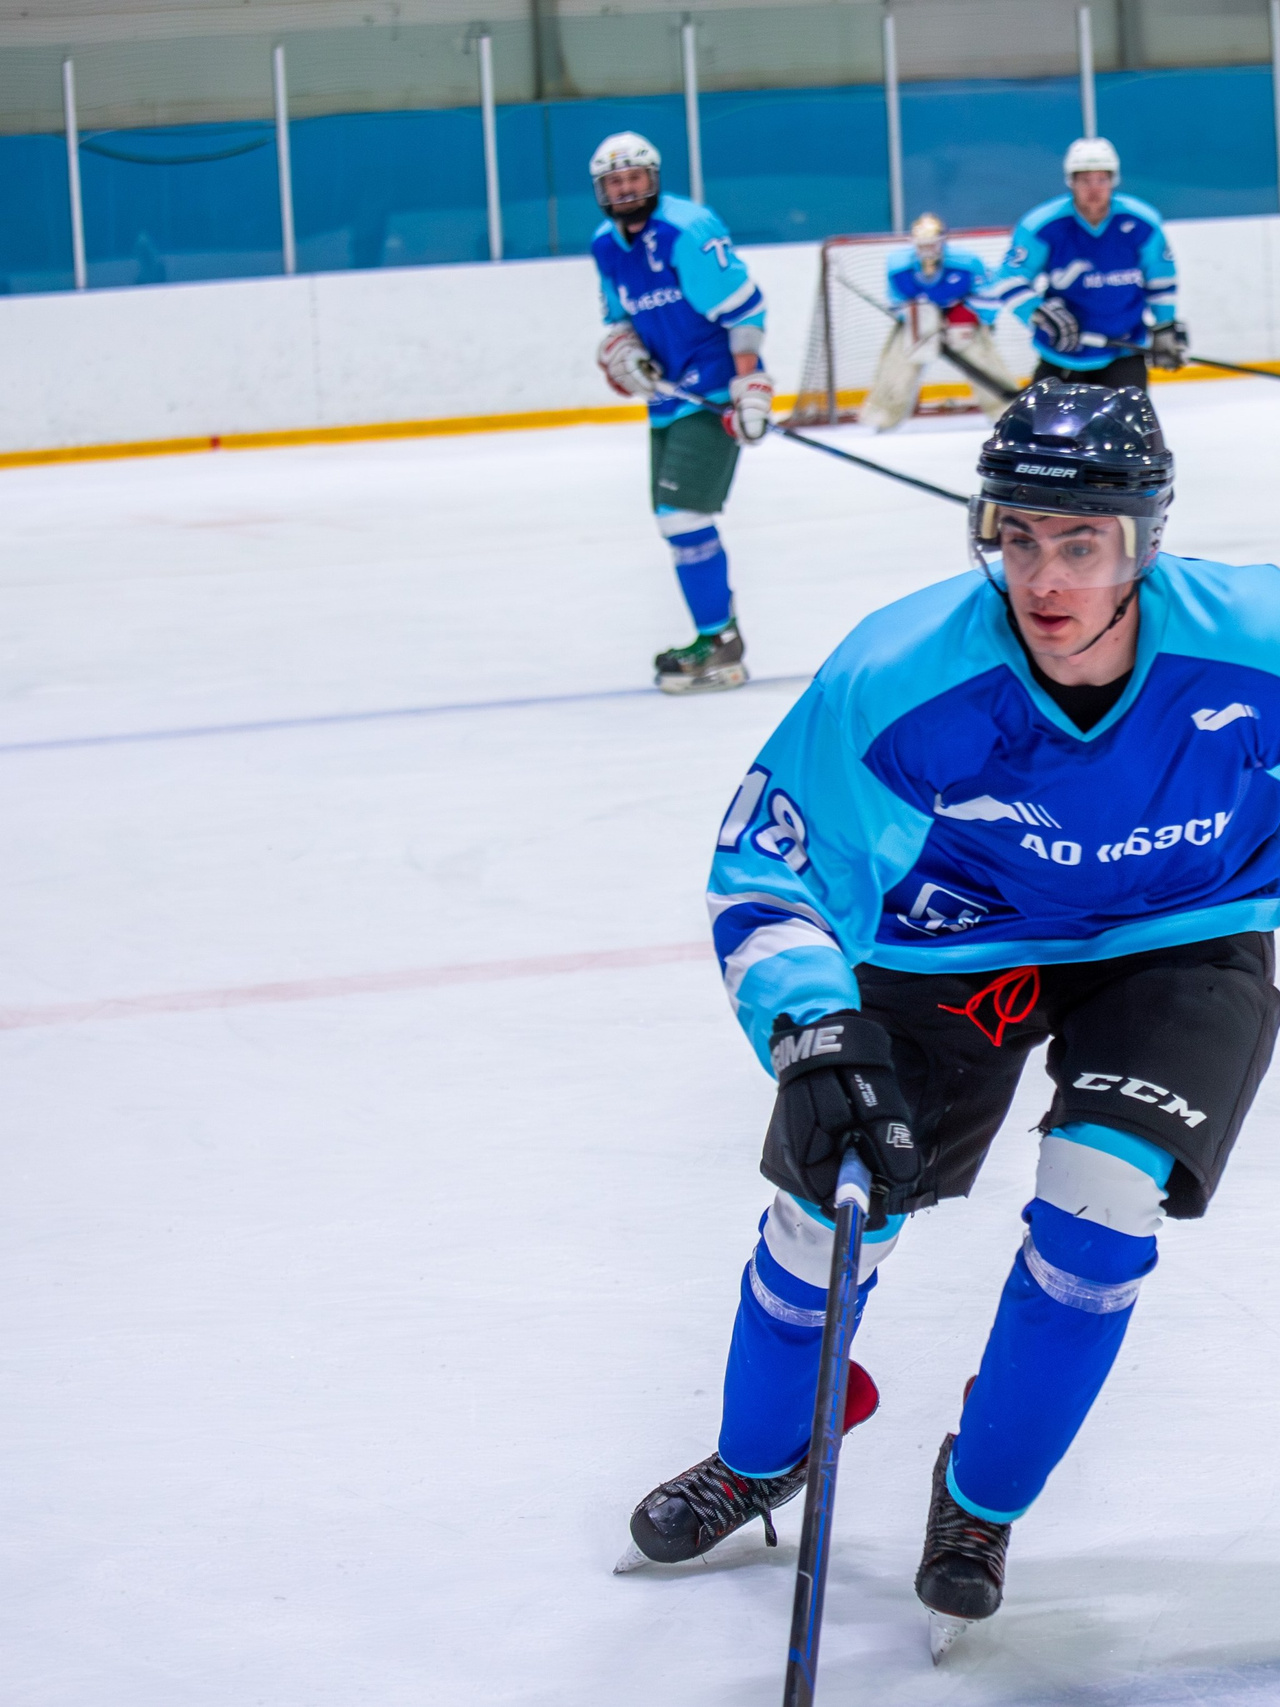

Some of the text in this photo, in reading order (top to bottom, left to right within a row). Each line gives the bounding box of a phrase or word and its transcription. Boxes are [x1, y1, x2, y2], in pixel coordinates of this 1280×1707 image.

[716, 762, 812, 876] 18
[1020, 833, 1082, 866] АО
[1072, 1072, 1208, 1129] CCM
